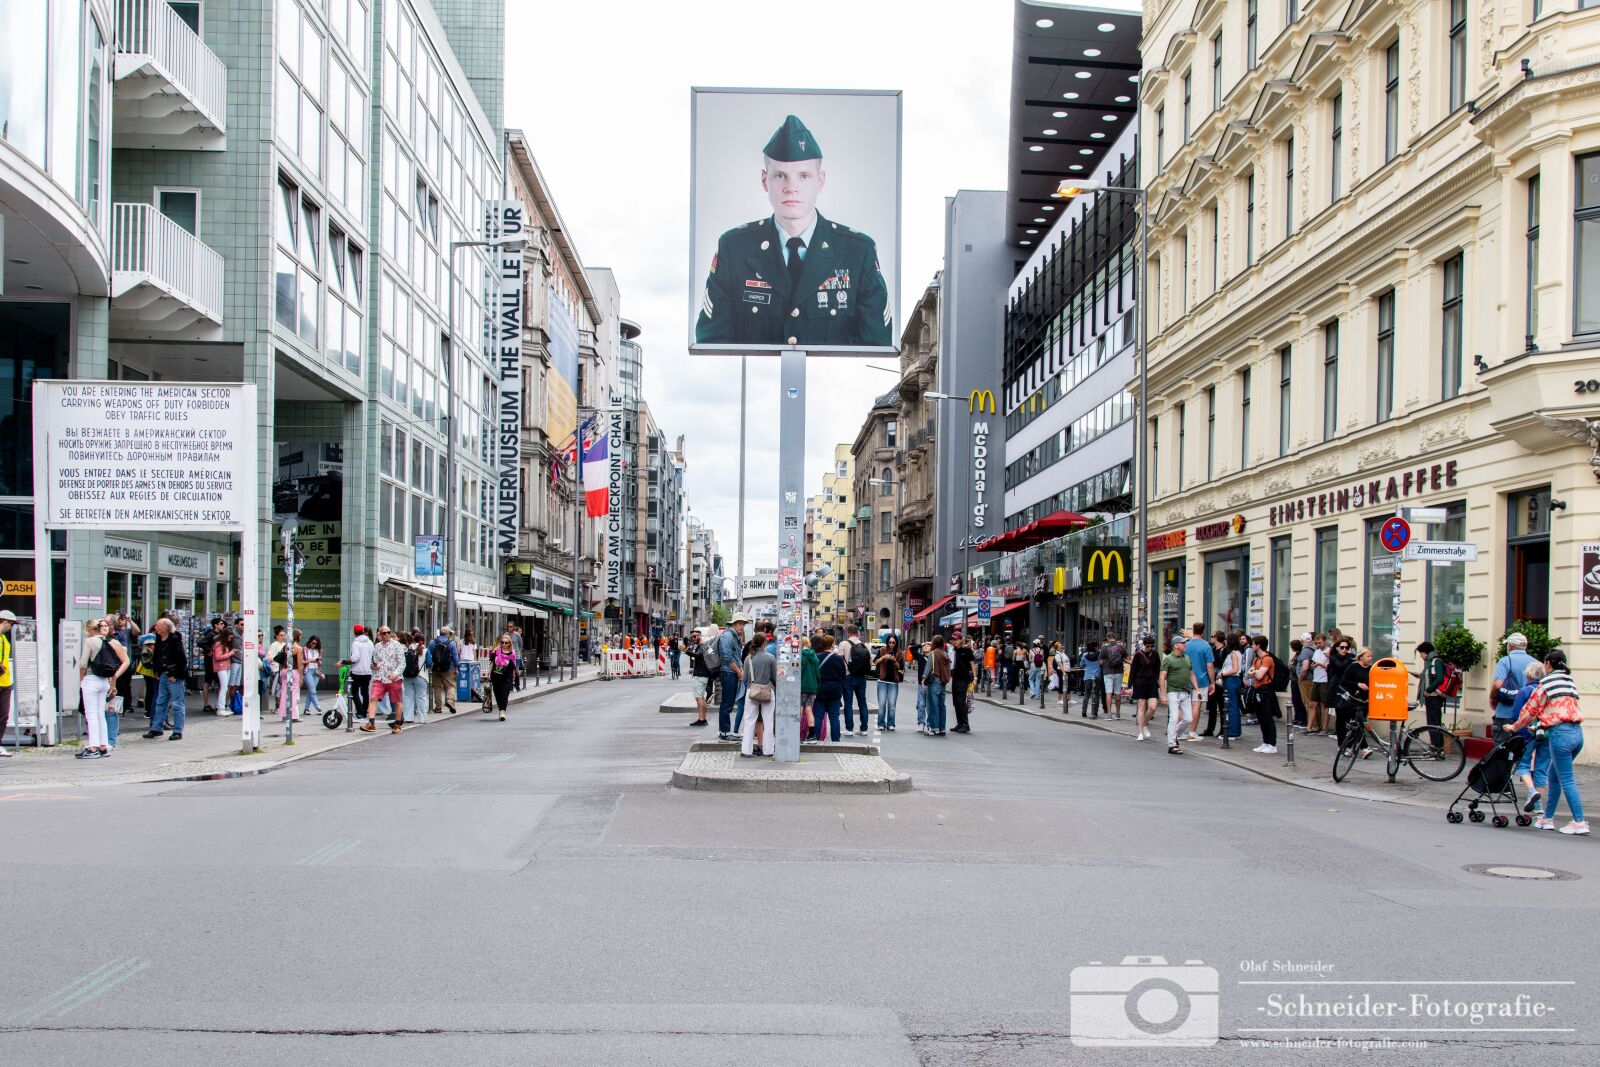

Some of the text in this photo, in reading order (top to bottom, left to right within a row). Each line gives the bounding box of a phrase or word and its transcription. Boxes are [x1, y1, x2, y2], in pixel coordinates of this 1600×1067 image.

[498, 208, 522, 548] MAUERMUSEUM THE WALL LE UR
[62, 386, 231, 398] YOU ARE ENTERING THE AMERICAN SECTOR
[1574, 380, 1600, 393] 20
[62, 398, 230, 410] CARRYING WEAPONS OFF DUTY FORBIDDEN
[106, 411, 188, 420] OBEY TRAFFIC RULES
[66, 428, 226, 439] ВЫ ВЕЗЖАЕТЕ В АМЕРИКАНСКИЙ СЕКТОР
[59, 439, 83, 449] НОСИТЬ
[85, 440, 112, 449] ОРУЖИЕ
[155, 441, 159, 449] В
[211, 441, 232, 451] ВРЕМЯ
[127, 452, 172, 461] ДОРОЖНЫМ
[60, 468, 80, 478] VOUS
[85, 469, 111, 478] ENTREZ
[116, 469, 136, 478] DANS
[140, 469, 147, 478] LE
[151, 470, 184, 479] SECTEUR
[974, 422, 989, 528] McDonald's
[60, 480, 232, 490] DEFENSE DE PORTER DES ARMES EN DEHORS DU SERVICE
[68, 491, 223, 501] OBEISSEZ AUX REGLES DE CIRCULATION
[608, 396, 622, 594] HAUS AM CHECKPOINT CHARIE
[1269, 460, 1458, 527] EINSTEIN KAFFEE
[60, 509, 231, 520] SIE BETRETEN DEN AMERIKANISCHEN SEKTOR
[323, 524, 335, 534] IN
[310, 542, 324, 550] BE
[1418, 546, 1466, 556] Zimmerstraße
[123, 548, 142, 561] CHARLIE
[317, 556, 332, 566] OF
[6, 584, 33, 592] CASH
[750, 580, 766, 589] ARMY
